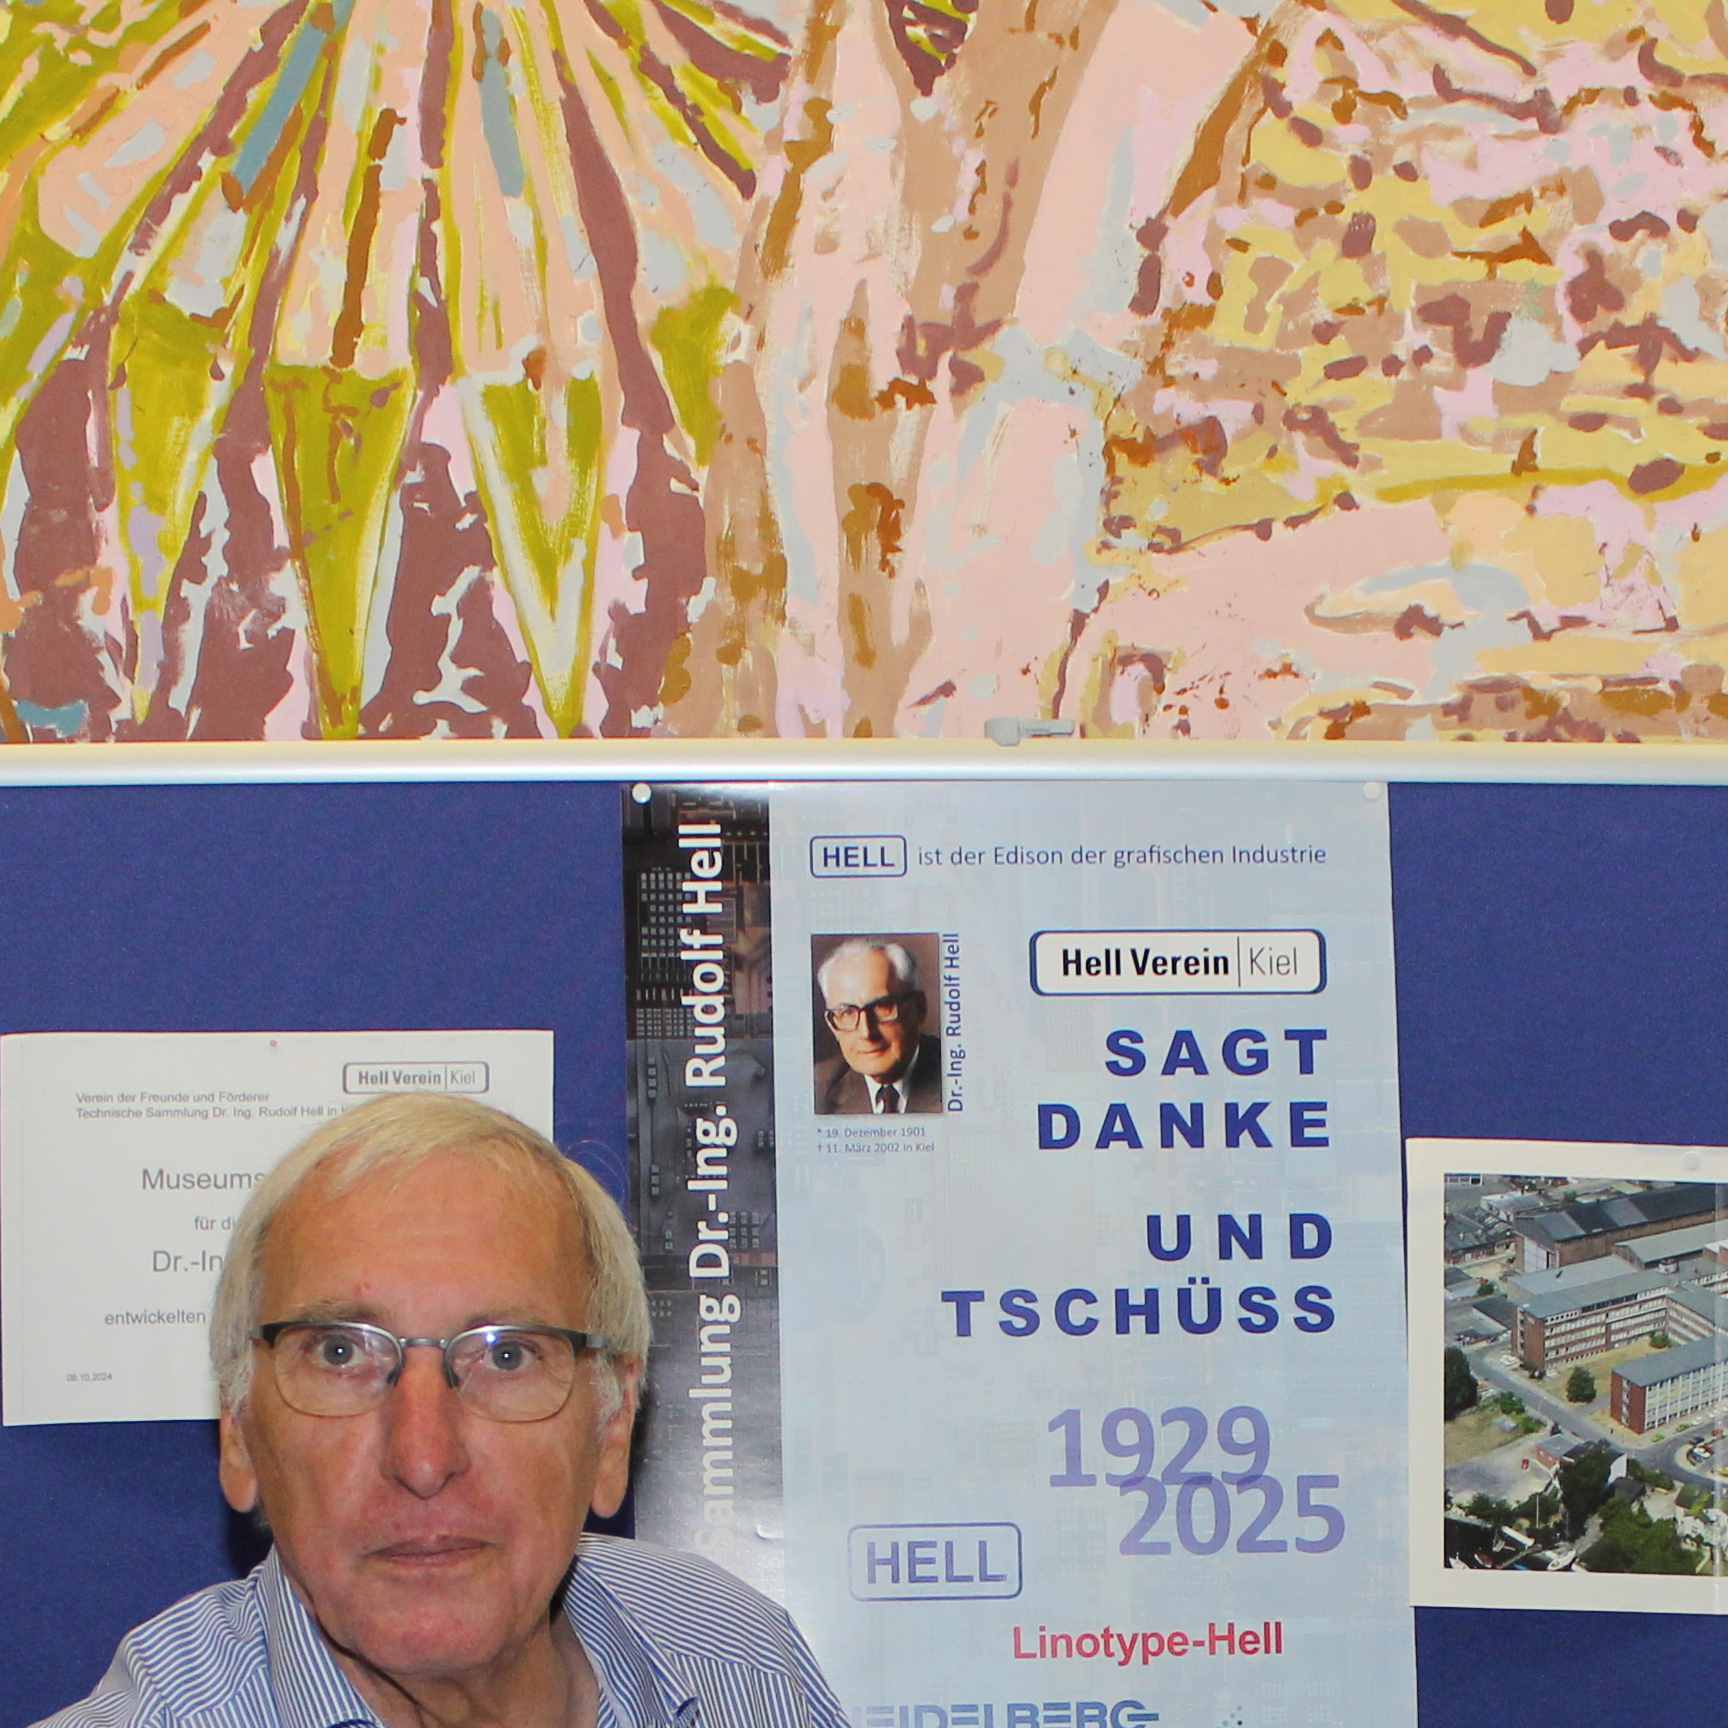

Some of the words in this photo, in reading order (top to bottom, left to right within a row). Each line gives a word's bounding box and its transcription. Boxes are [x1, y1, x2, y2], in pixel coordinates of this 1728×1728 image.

[678, 824, 723, 914] Hell
[822, 846, 895, 868] HELL
[918, 846, 942, 865] ist
[950, 847, 985, 865] der
[994, 846, 1063, 865] Edison
[1071, 845, 1107, 865] der
[1113, 844, 1224, 869] grafischen
[1231, 844, 1327, 865] Industrie
[943, 934, 960, 968] Hell
[1061, 948, 1121, 977] Hell
[1131, 948, 1229, 976] Verein
[1249, 946, 1299, 976] Kiel
[681, 929, 726, 1087] Rudolf
[944, 975, 960, 1037] Rudolf
[1105, 1029, 1329, 1079] SAGT
[76, 1092, 113, 1104] Verein
[117, 1092, 137, 1104] der
[140, 1092, 189, 1104] Freunde
[193, 1092, 215, 1103] und
[219, 1091, 270, 1103] Förderer
[358, 1071, 388, 1085] Hell
[392, 1071, 441, 1084] Verein
[450, 1071, 475, 1084] Kiel
[947, 1045, 965, 1112] Dr.-Ing.
[77, 1108, 142, 1119] Technische
[146, 1107, 208, 1120] Sammlung
[259, 1106, 297, 1117] Rudolf
[301, 1106, 323, 1116] Hell
[844, 1128, 897, 1138] Dezember
[901, 1127, 925, 1136] 1901
[1038, 1101, 1331, 1150] DANKE
[142, 1168, 264, 1190] Museums
[688, 1104, 739, 1279] Dr.-Ing.
[194, 1216, 216, 1230] für
[1146, 1213, 1333, 1261] UND
[153, 1251, 224, 1272] Dr.-In
[104, 1309, 206, 1325] entwickelten
[941, 1276, 1337, 1338] TSCHÜSS
[1047, 1405, 1271, 1488] 1929
[1119, 1474, 1345, 1556] 2025
[866, 1540, 1008, 1585] HELL
[1013, 1621, 1282, 1666] Linotype-Hell
